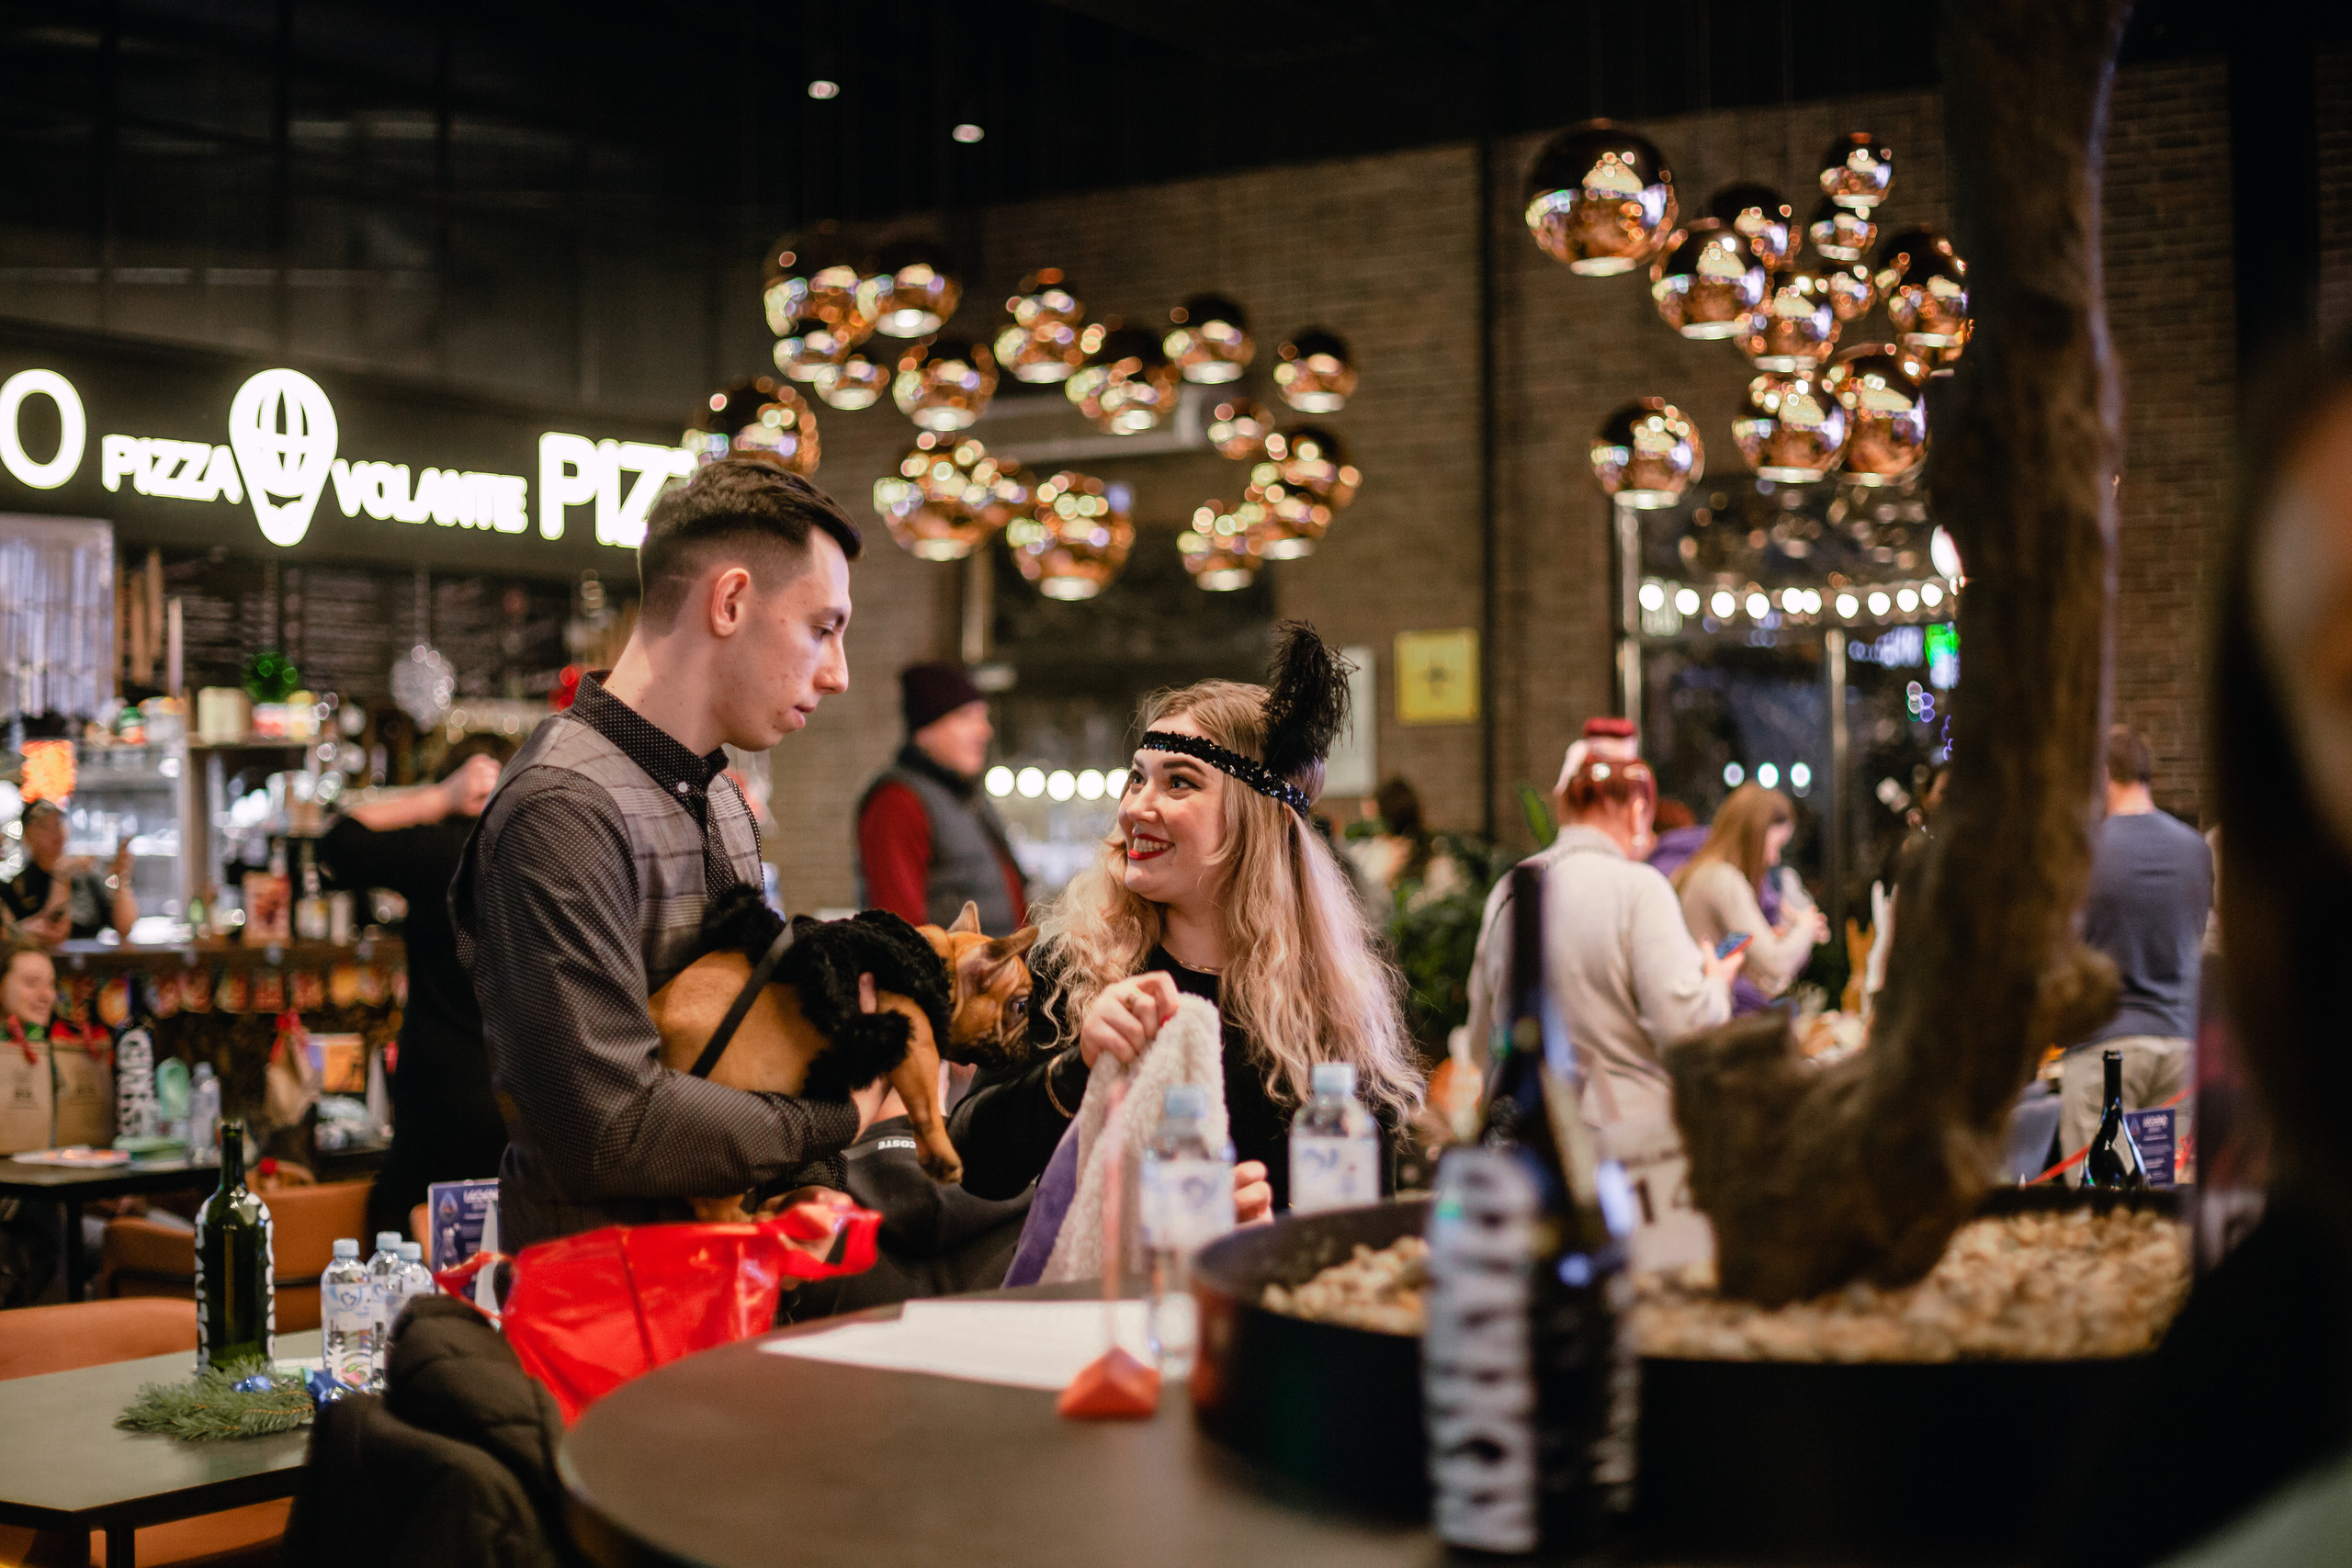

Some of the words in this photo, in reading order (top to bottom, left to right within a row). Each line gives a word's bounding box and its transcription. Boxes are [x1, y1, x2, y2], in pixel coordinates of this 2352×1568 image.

[0, 368, 86, 490] O
[102, 434, 243, 504] PIZZA
[330, 457, 528, 534] VOLANTE
[877, 1139, 917, 1150] COSTE
